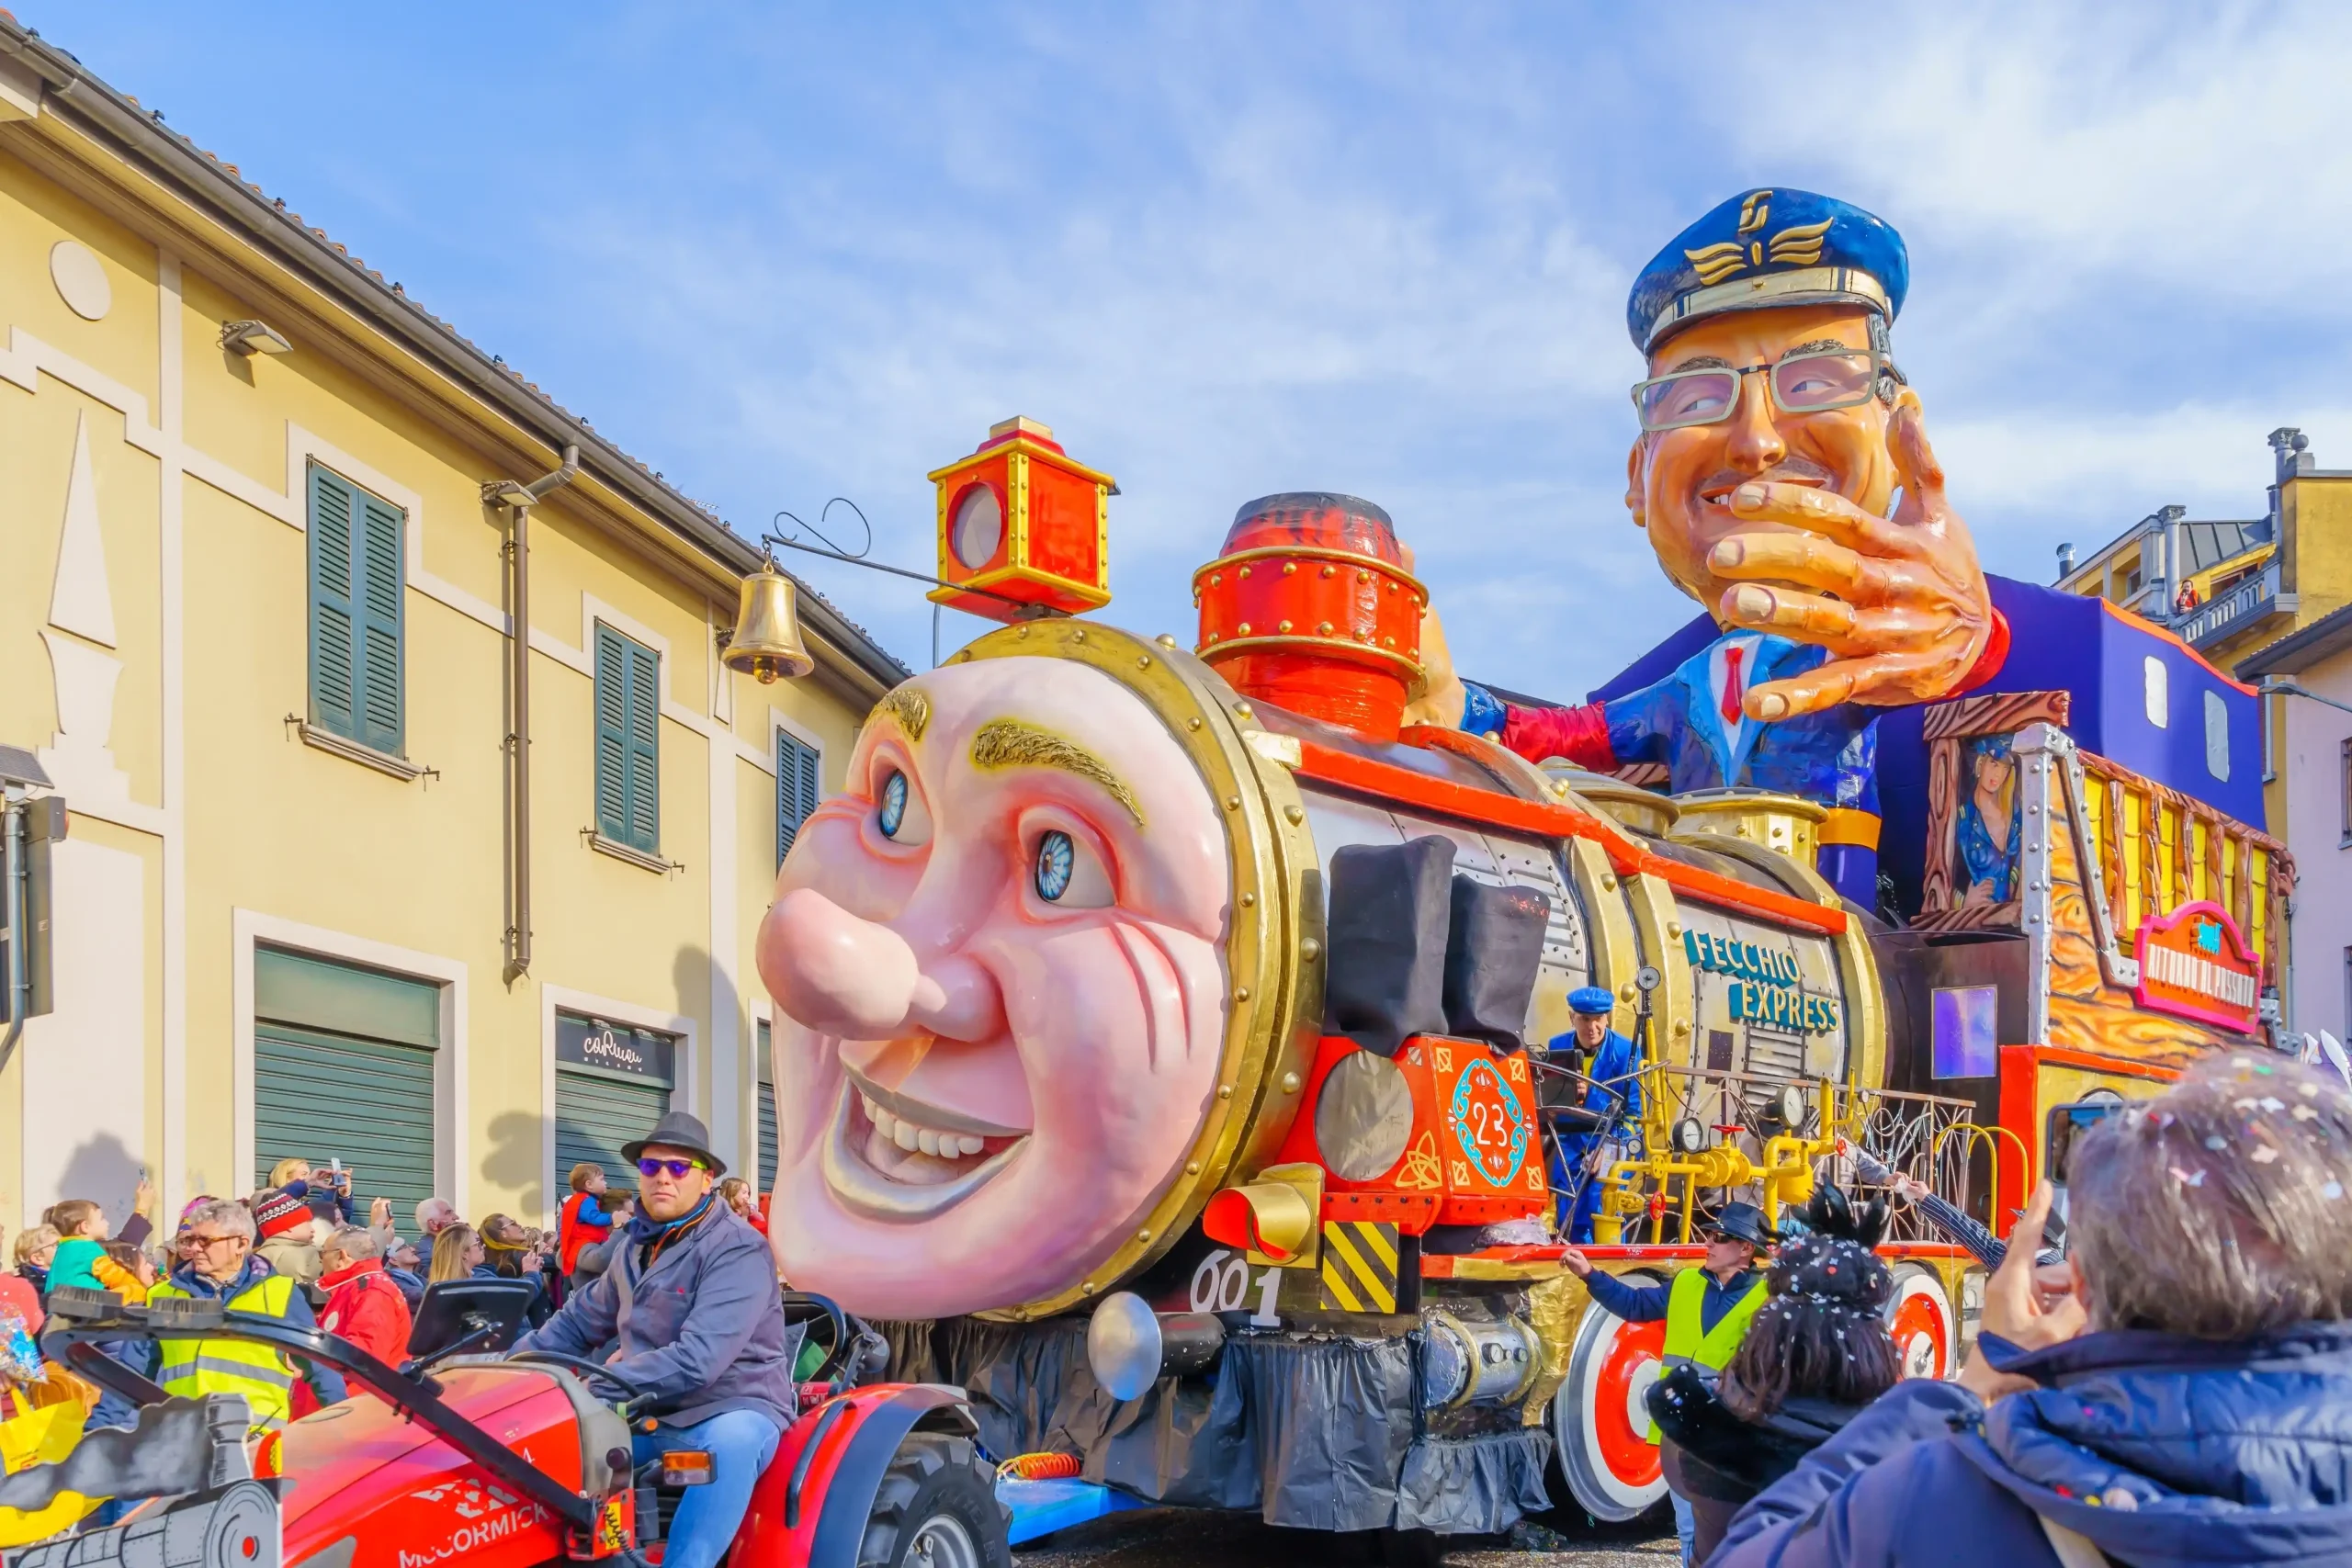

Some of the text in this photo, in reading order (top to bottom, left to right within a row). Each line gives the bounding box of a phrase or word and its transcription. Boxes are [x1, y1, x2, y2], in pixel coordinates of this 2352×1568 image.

[1690, 929, 1802, 983] FECCHIO
[1740, 982, 1840, 1032] EXPRESS
[1473, 1101, 1509, 1147] 23
